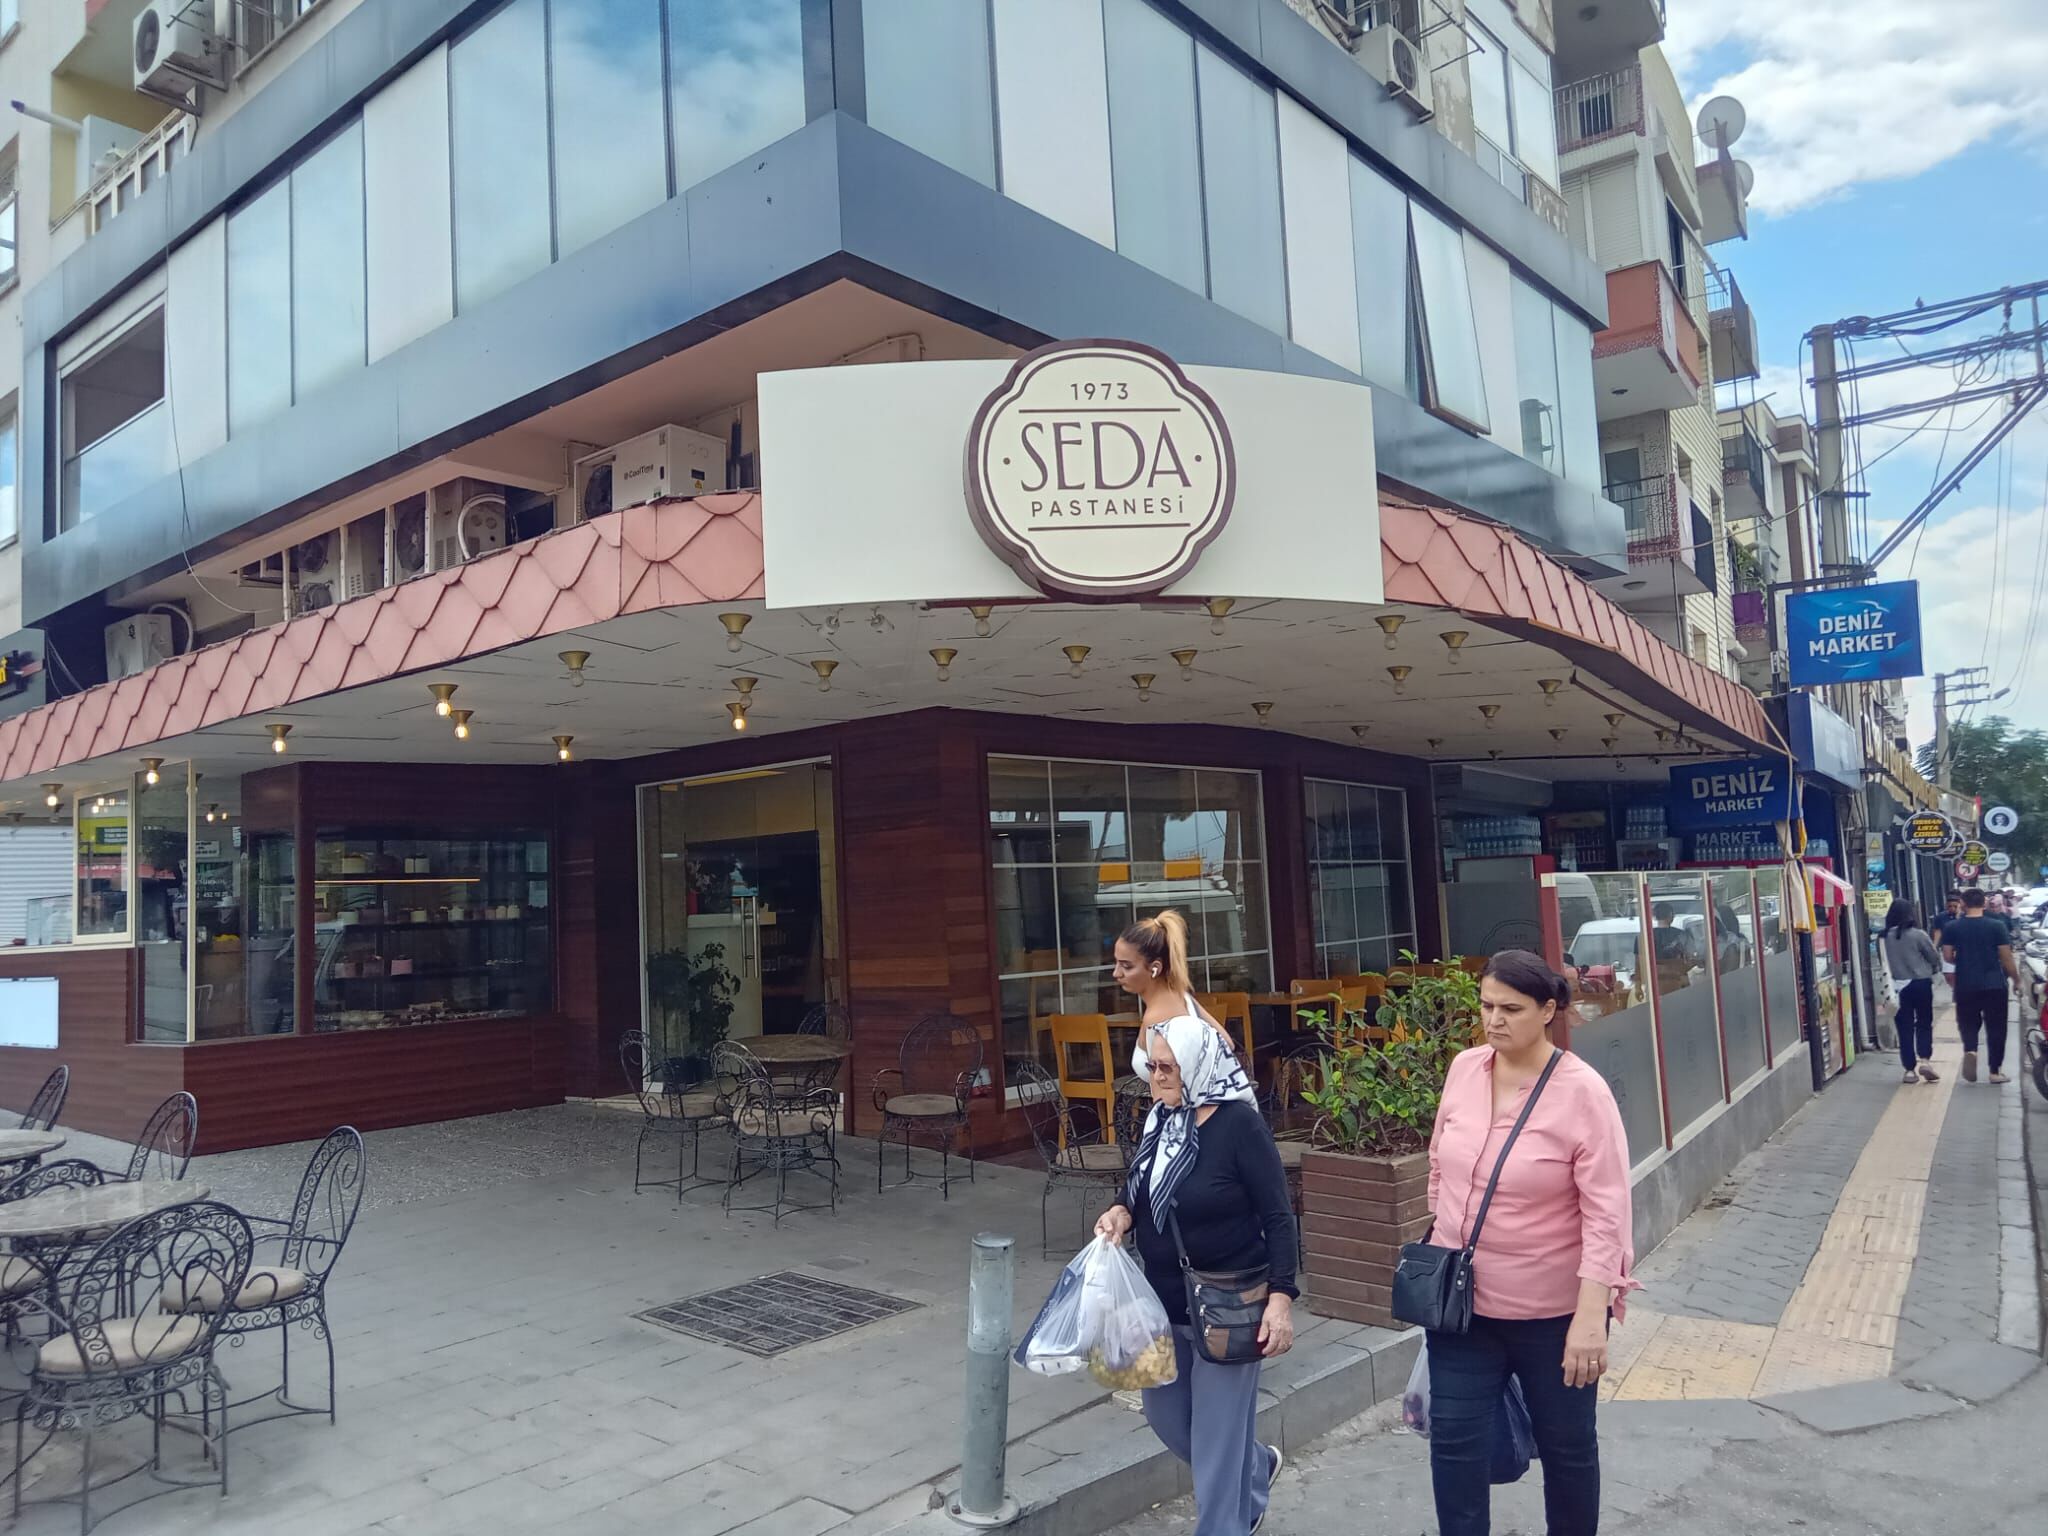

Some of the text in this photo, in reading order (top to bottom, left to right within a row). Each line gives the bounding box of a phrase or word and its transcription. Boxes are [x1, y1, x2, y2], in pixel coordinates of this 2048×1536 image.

[1071, 383, 1129, 400] 1973
[1021, 420, 1192, 492] SEDA
[1819, 609, 1883, 634] DENİZ
[1809, 632, 1896, 656] MARKET
[1691, 766, 1775, 799] DENİZ
[1705, 797, 1764, 814] MARKET
[1696, 831, 1761, 846] MARKET
